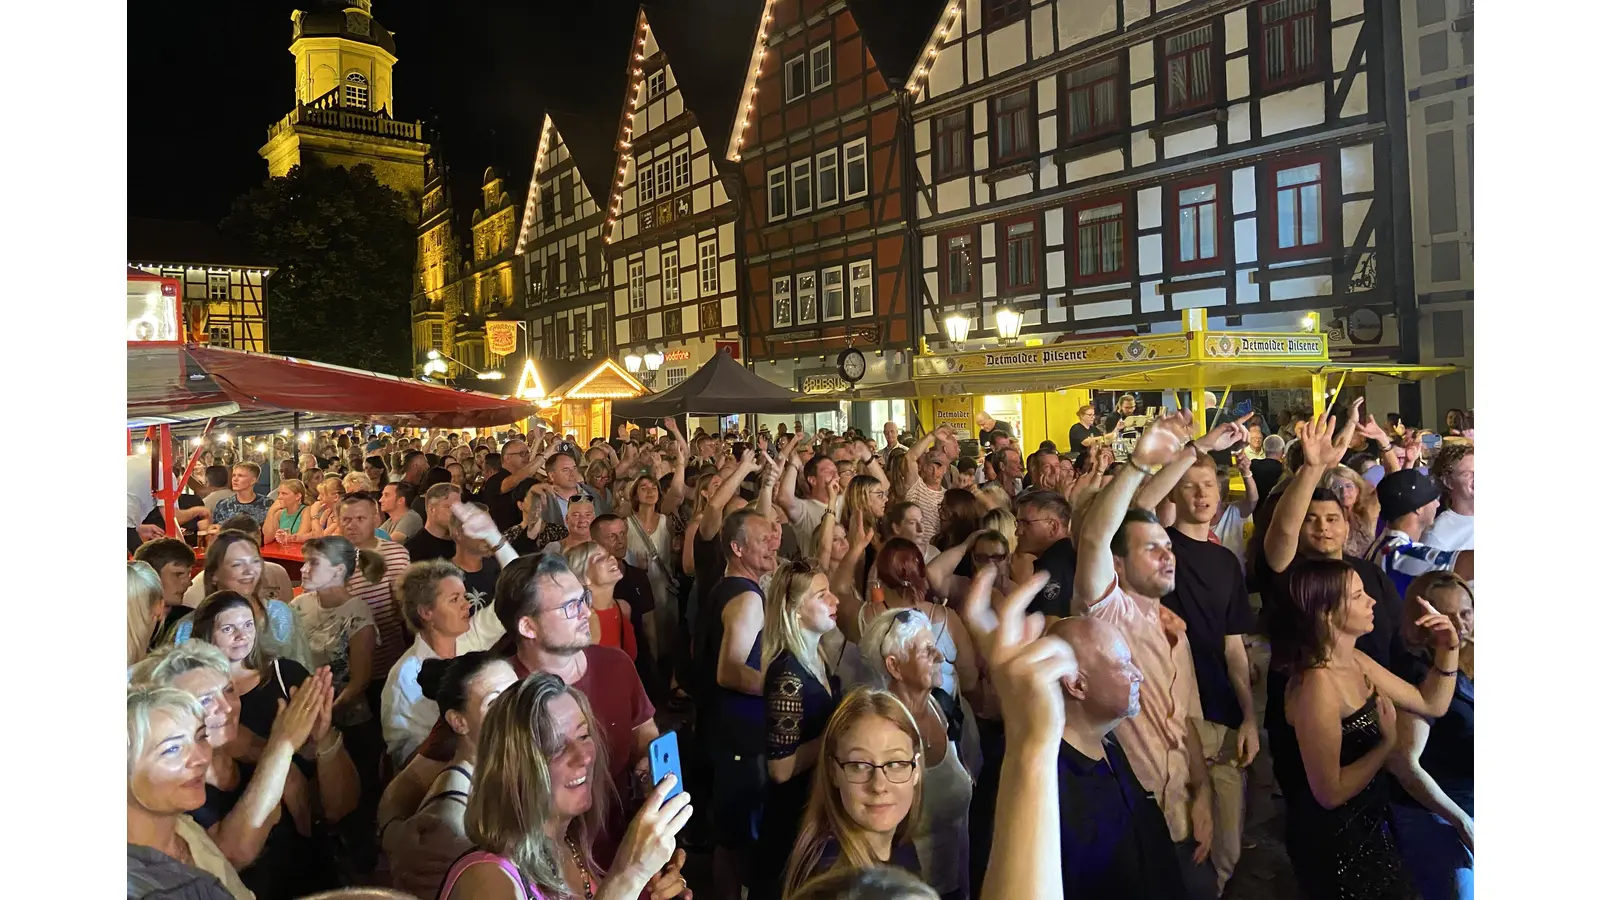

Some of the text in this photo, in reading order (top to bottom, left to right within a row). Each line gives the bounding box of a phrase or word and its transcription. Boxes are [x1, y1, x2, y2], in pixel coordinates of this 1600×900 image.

[1241, 338, 1319, 353] Detmolder Pilsener
[664, 350, 690, 361] vodafone
[986, 350, 1087, 366] Detmolder Pilsener
[803, 377, 846, 392] EPHESUS
